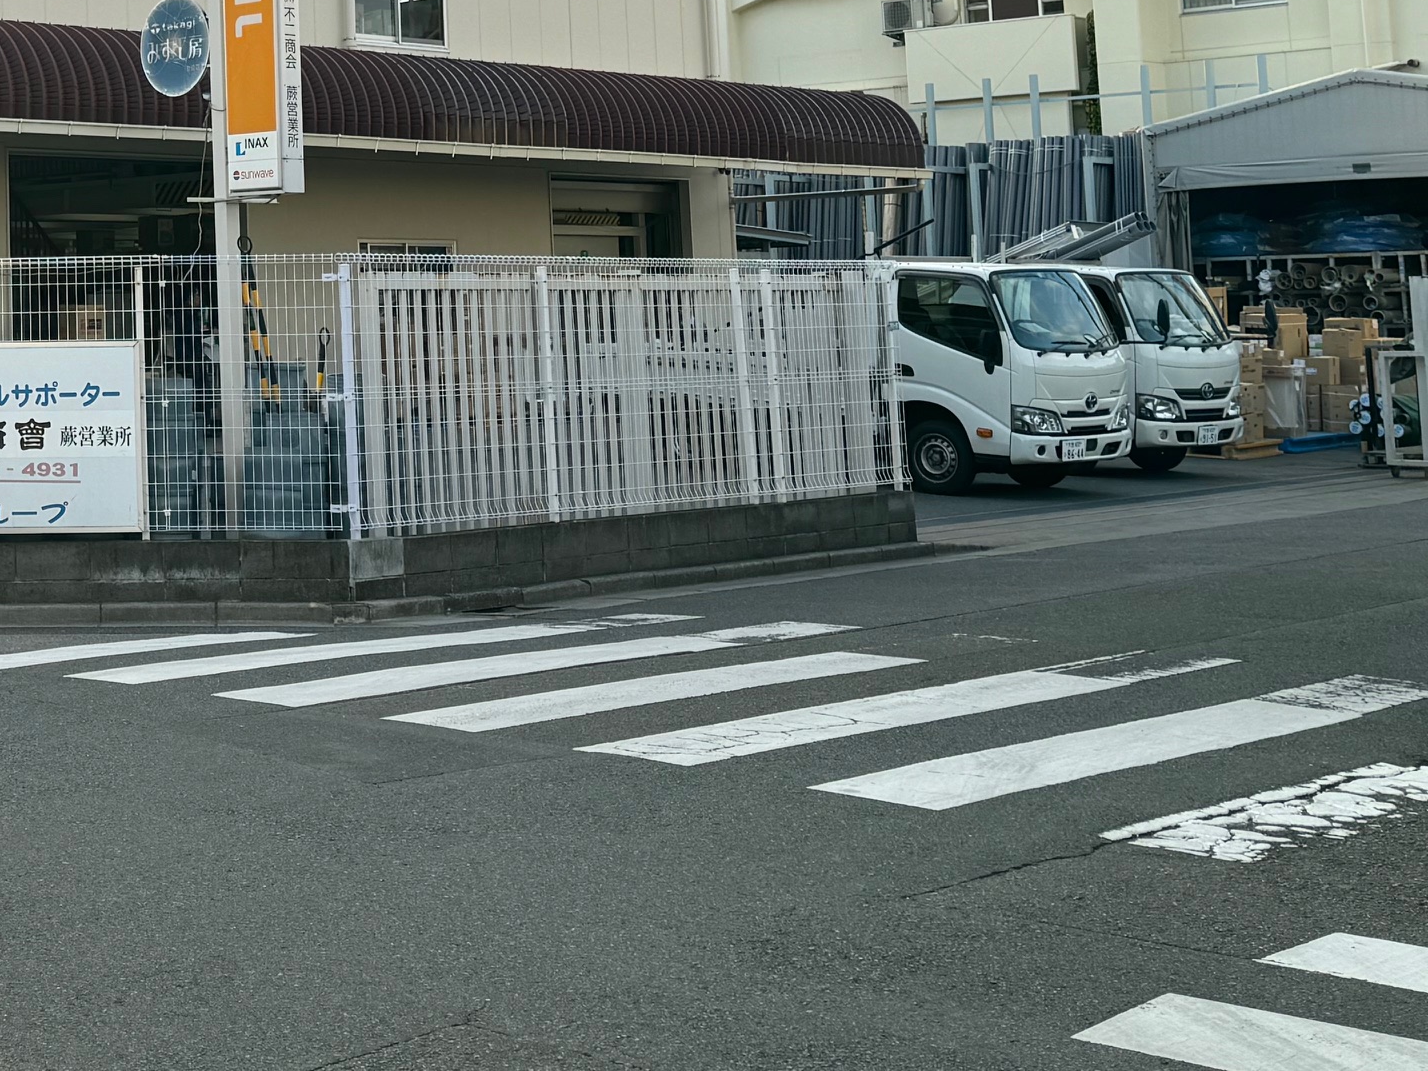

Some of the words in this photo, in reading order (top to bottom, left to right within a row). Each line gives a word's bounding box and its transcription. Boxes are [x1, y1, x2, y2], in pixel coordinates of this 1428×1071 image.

[244, 136, 269, 149] INAX
[240, 169, 274, 180] sunwave
[59, 425, 133, 448] 蕨営業所
